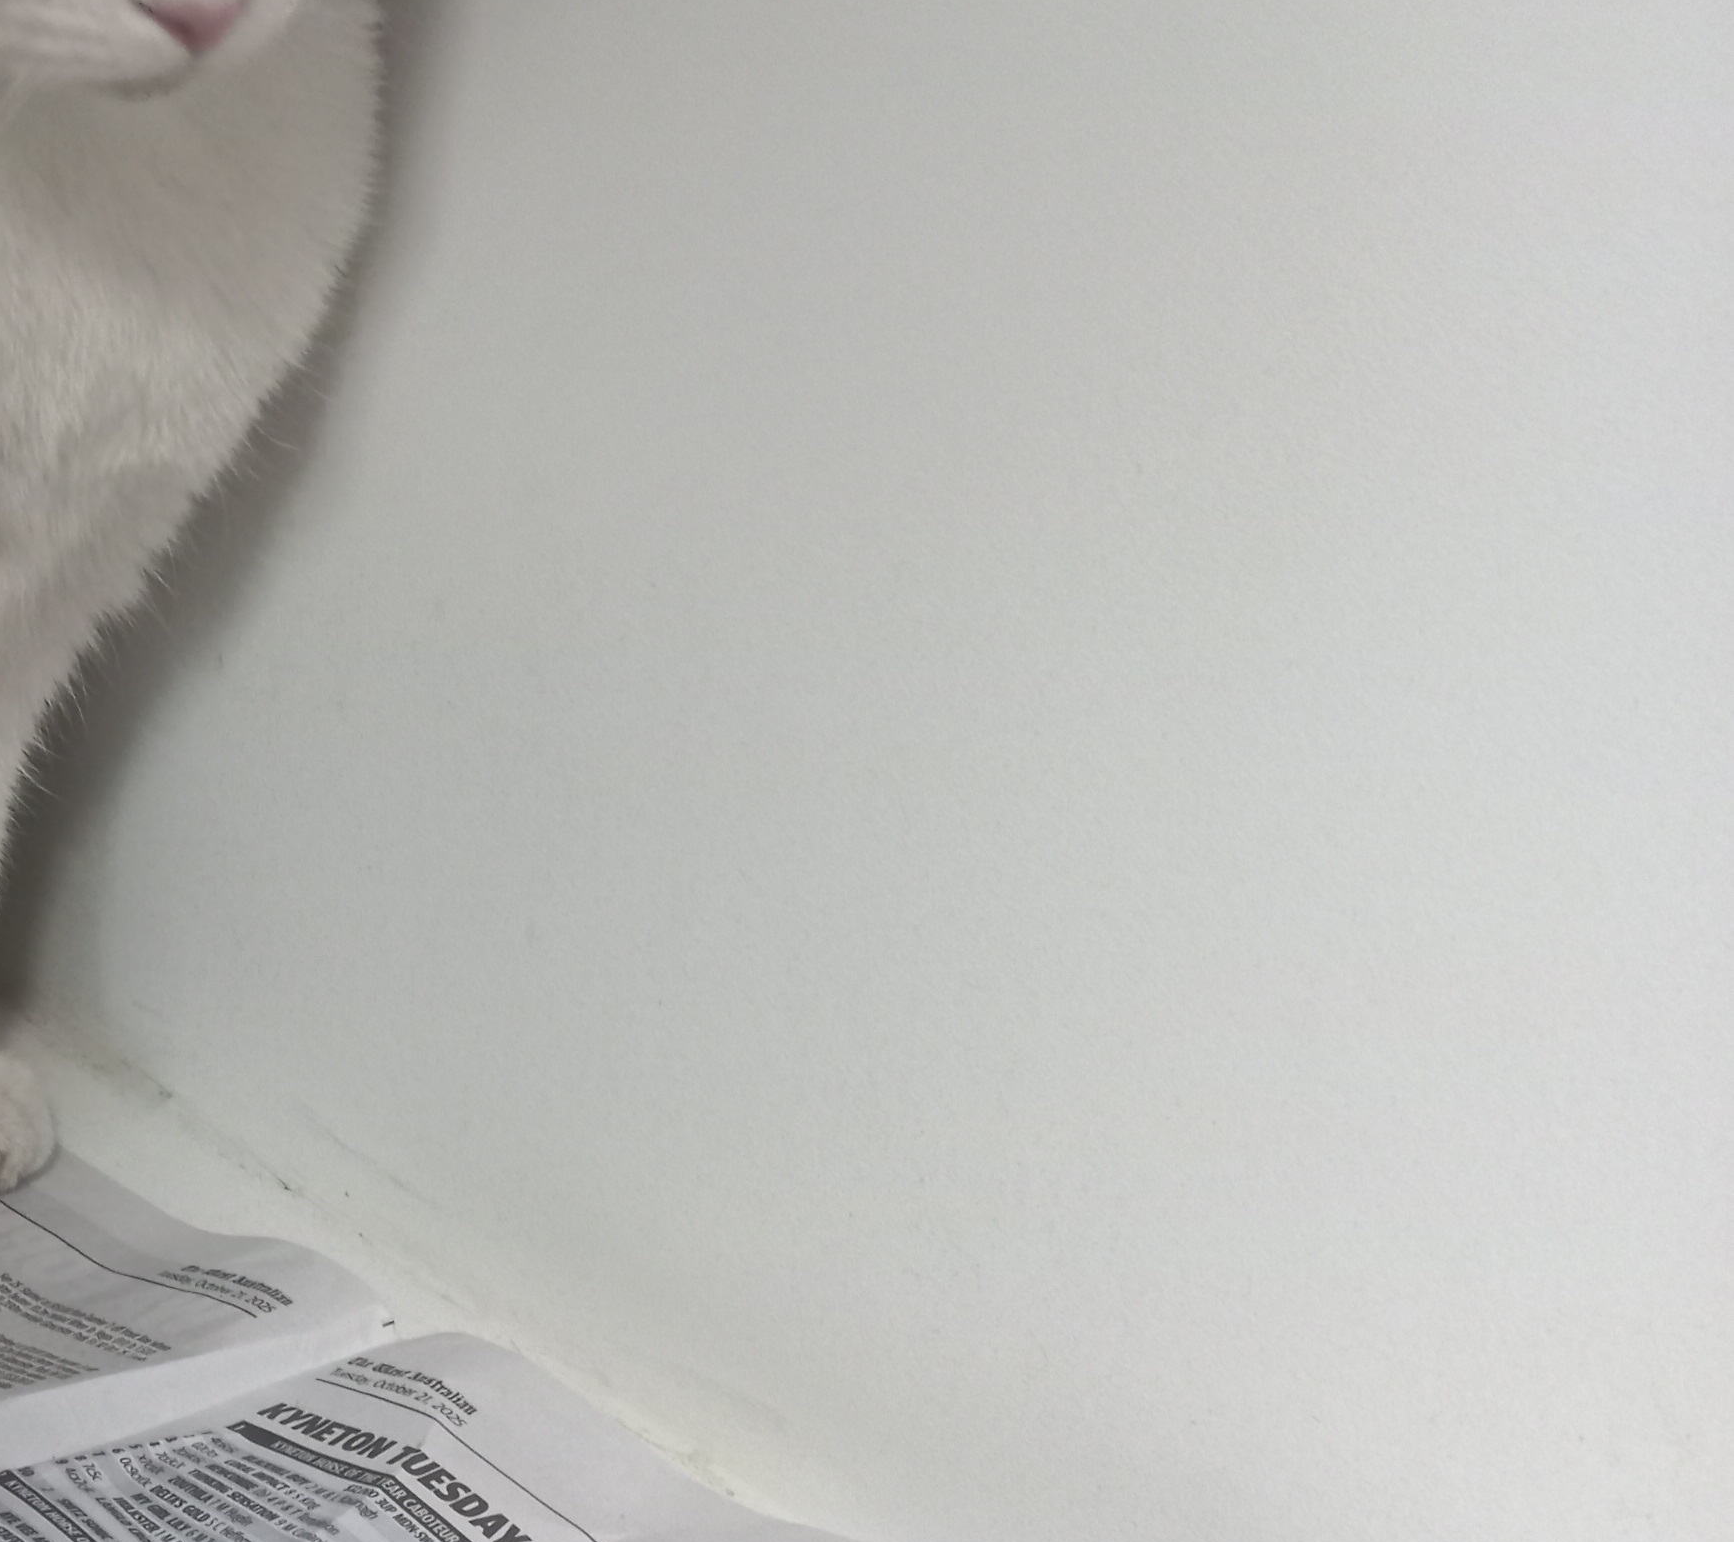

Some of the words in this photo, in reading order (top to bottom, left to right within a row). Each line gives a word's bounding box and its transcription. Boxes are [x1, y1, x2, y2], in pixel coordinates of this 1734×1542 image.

[373, 1379, 417, 1397] October
[432, 1403, 468, 1427] 2025
[408, 1372, 478, 1416] Australian
[256, 1402, 398, 1460] KYNETON
